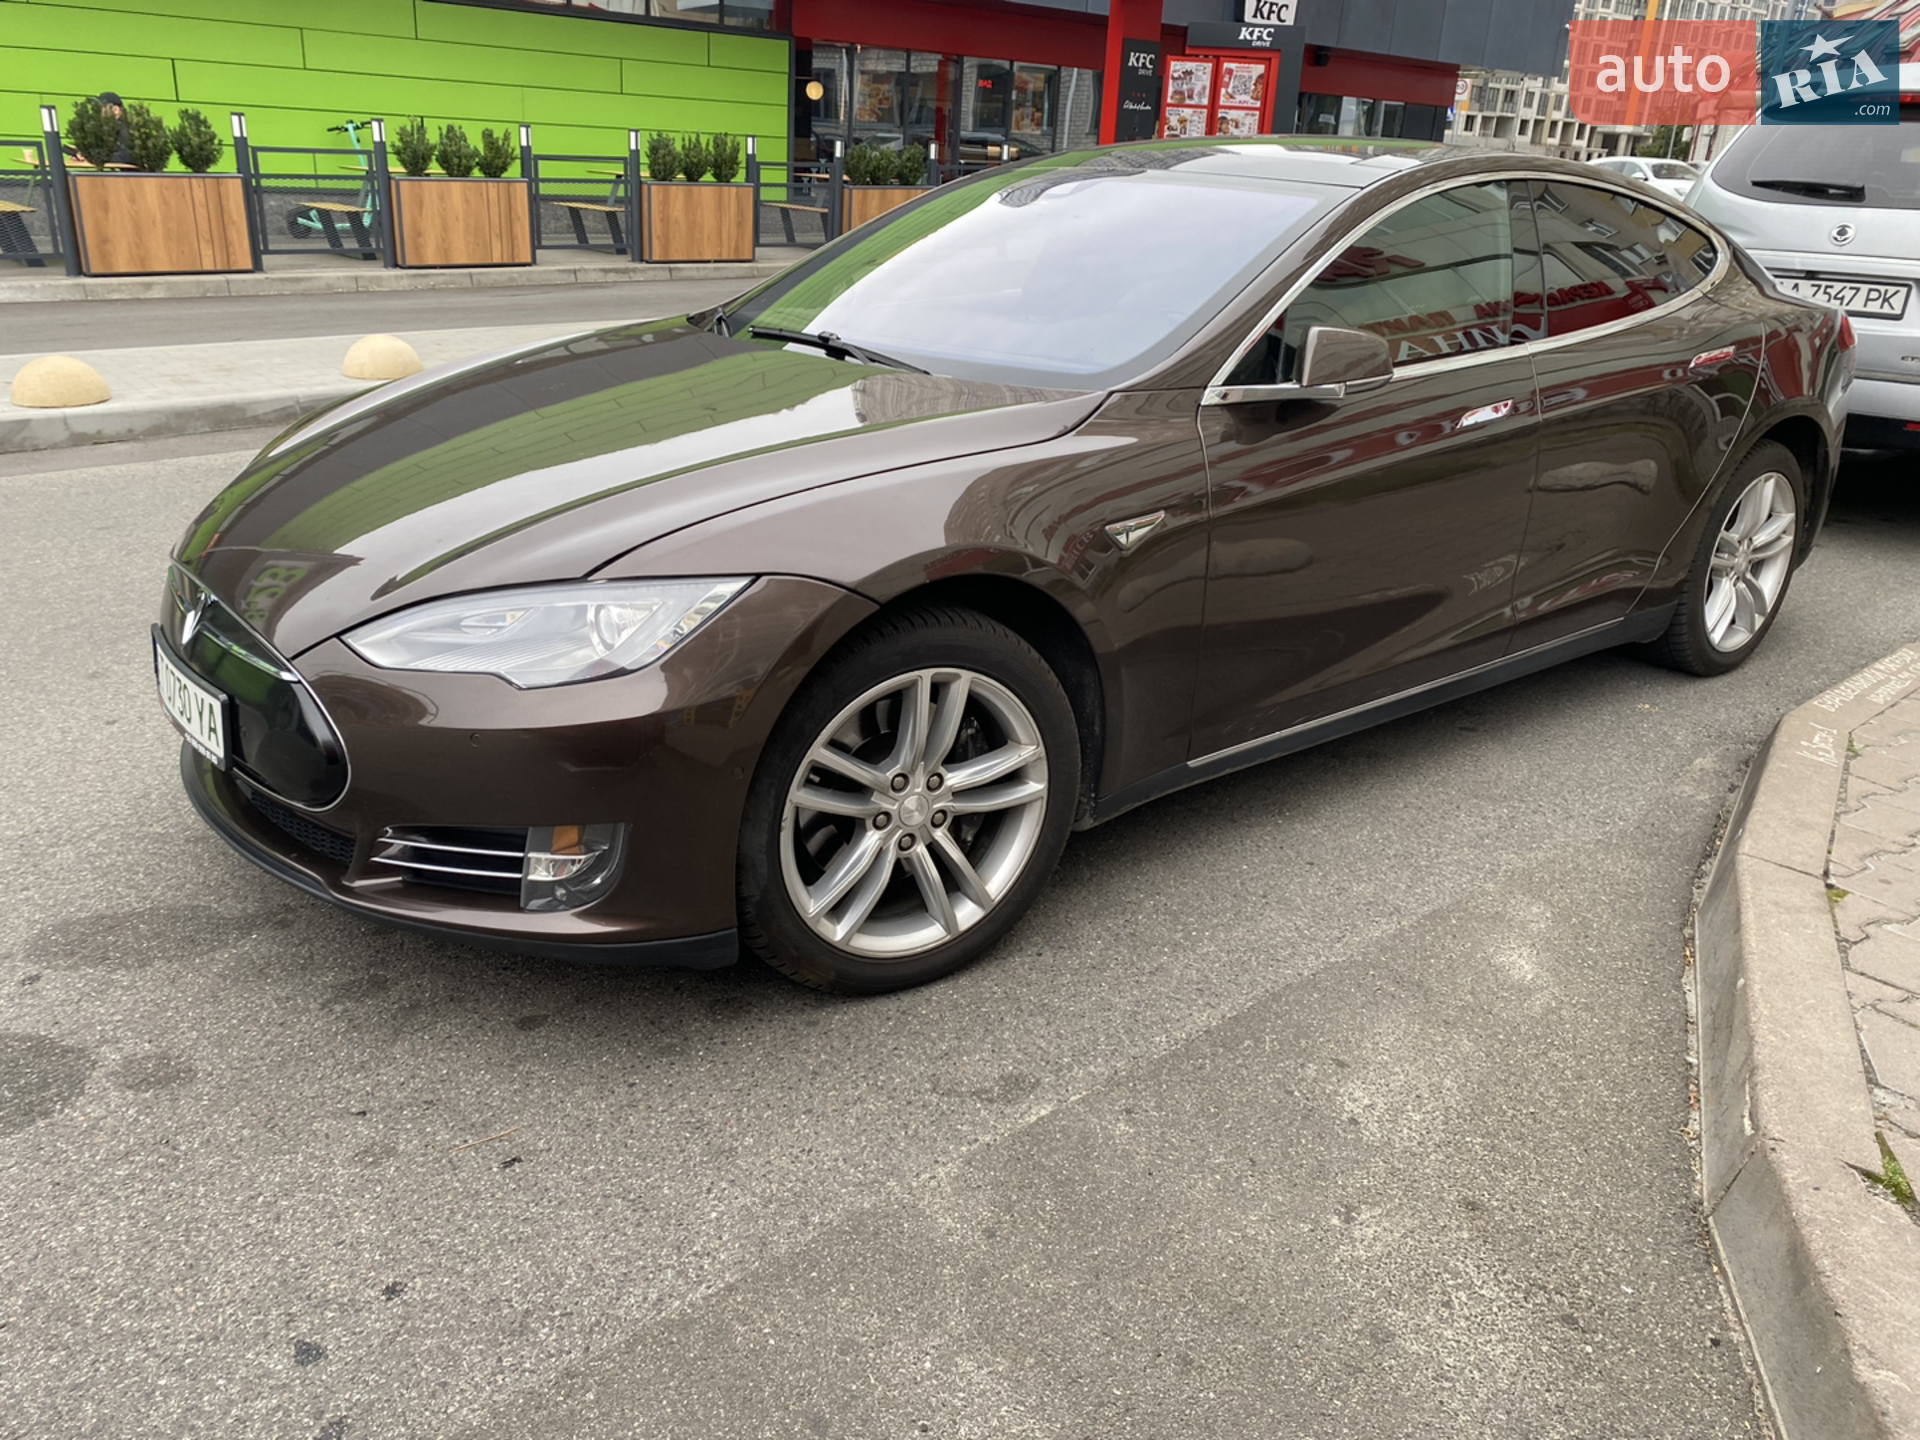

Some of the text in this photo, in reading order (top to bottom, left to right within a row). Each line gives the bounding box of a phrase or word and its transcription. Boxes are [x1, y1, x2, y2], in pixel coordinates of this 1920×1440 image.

[1252, 0, 1289, 23] KFC
[1238, 27, 1275, 41] KFC
[1127, 52, 1155, 69] KFC
[1810, 283, 1861, 307] 7547
[1863, 288, 1901, 311] PK
